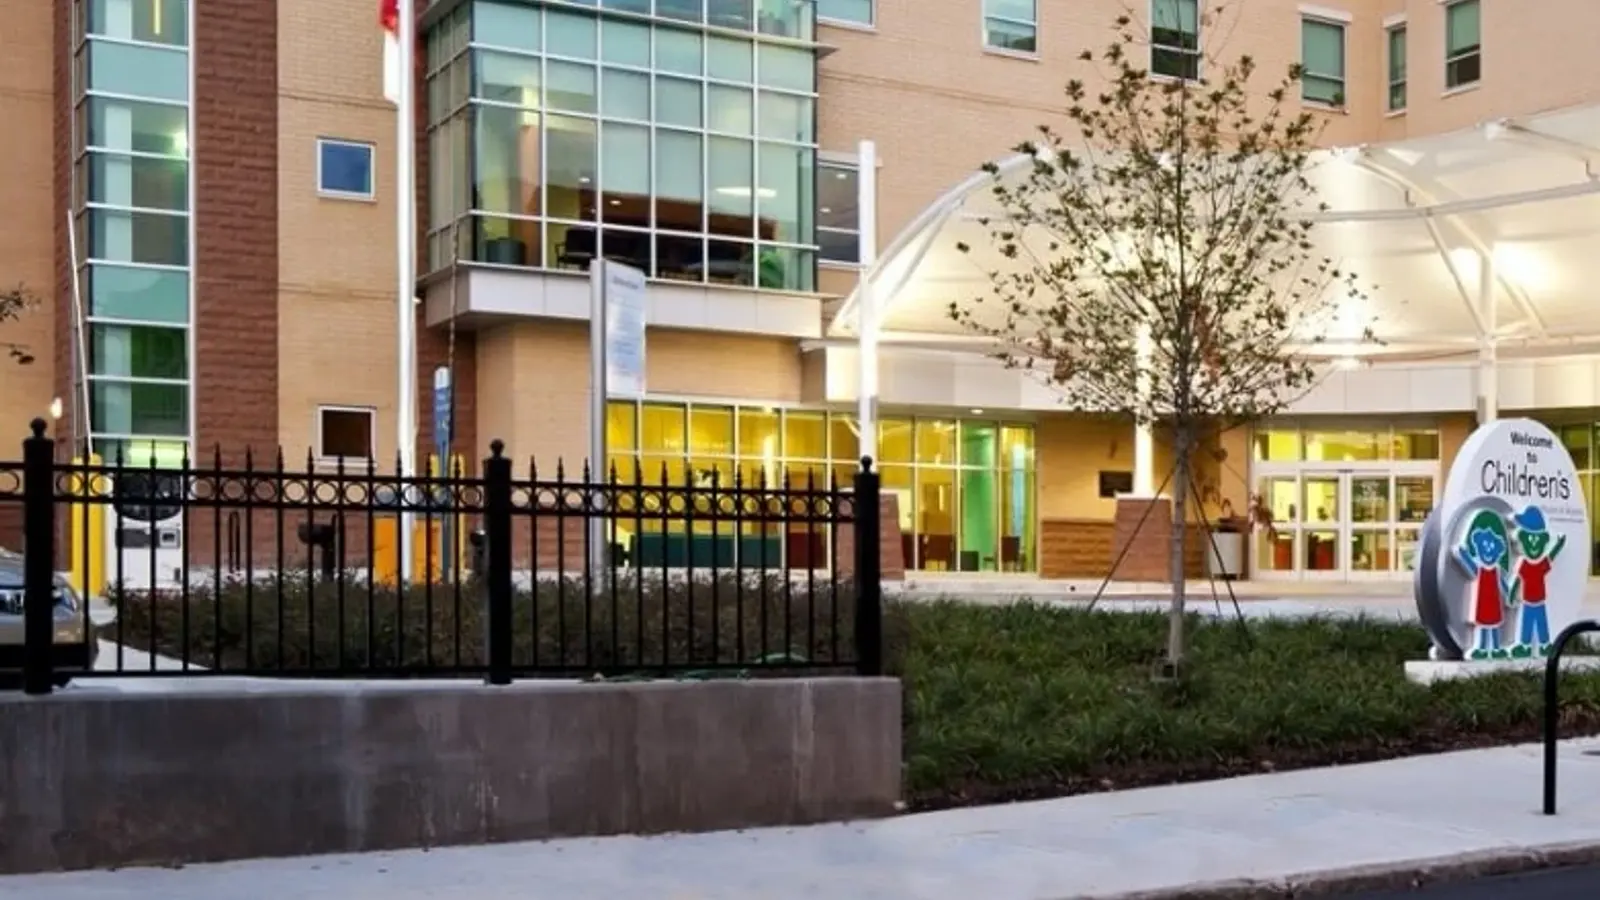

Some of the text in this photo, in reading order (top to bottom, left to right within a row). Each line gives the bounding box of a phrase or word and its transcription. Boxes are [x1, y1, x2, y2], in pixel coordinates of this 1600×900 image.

[1510, 431, 1553, 448] Welcome
[1526, 452, 1538, 463] to
[1481, 459, 1570, 500] Children's
